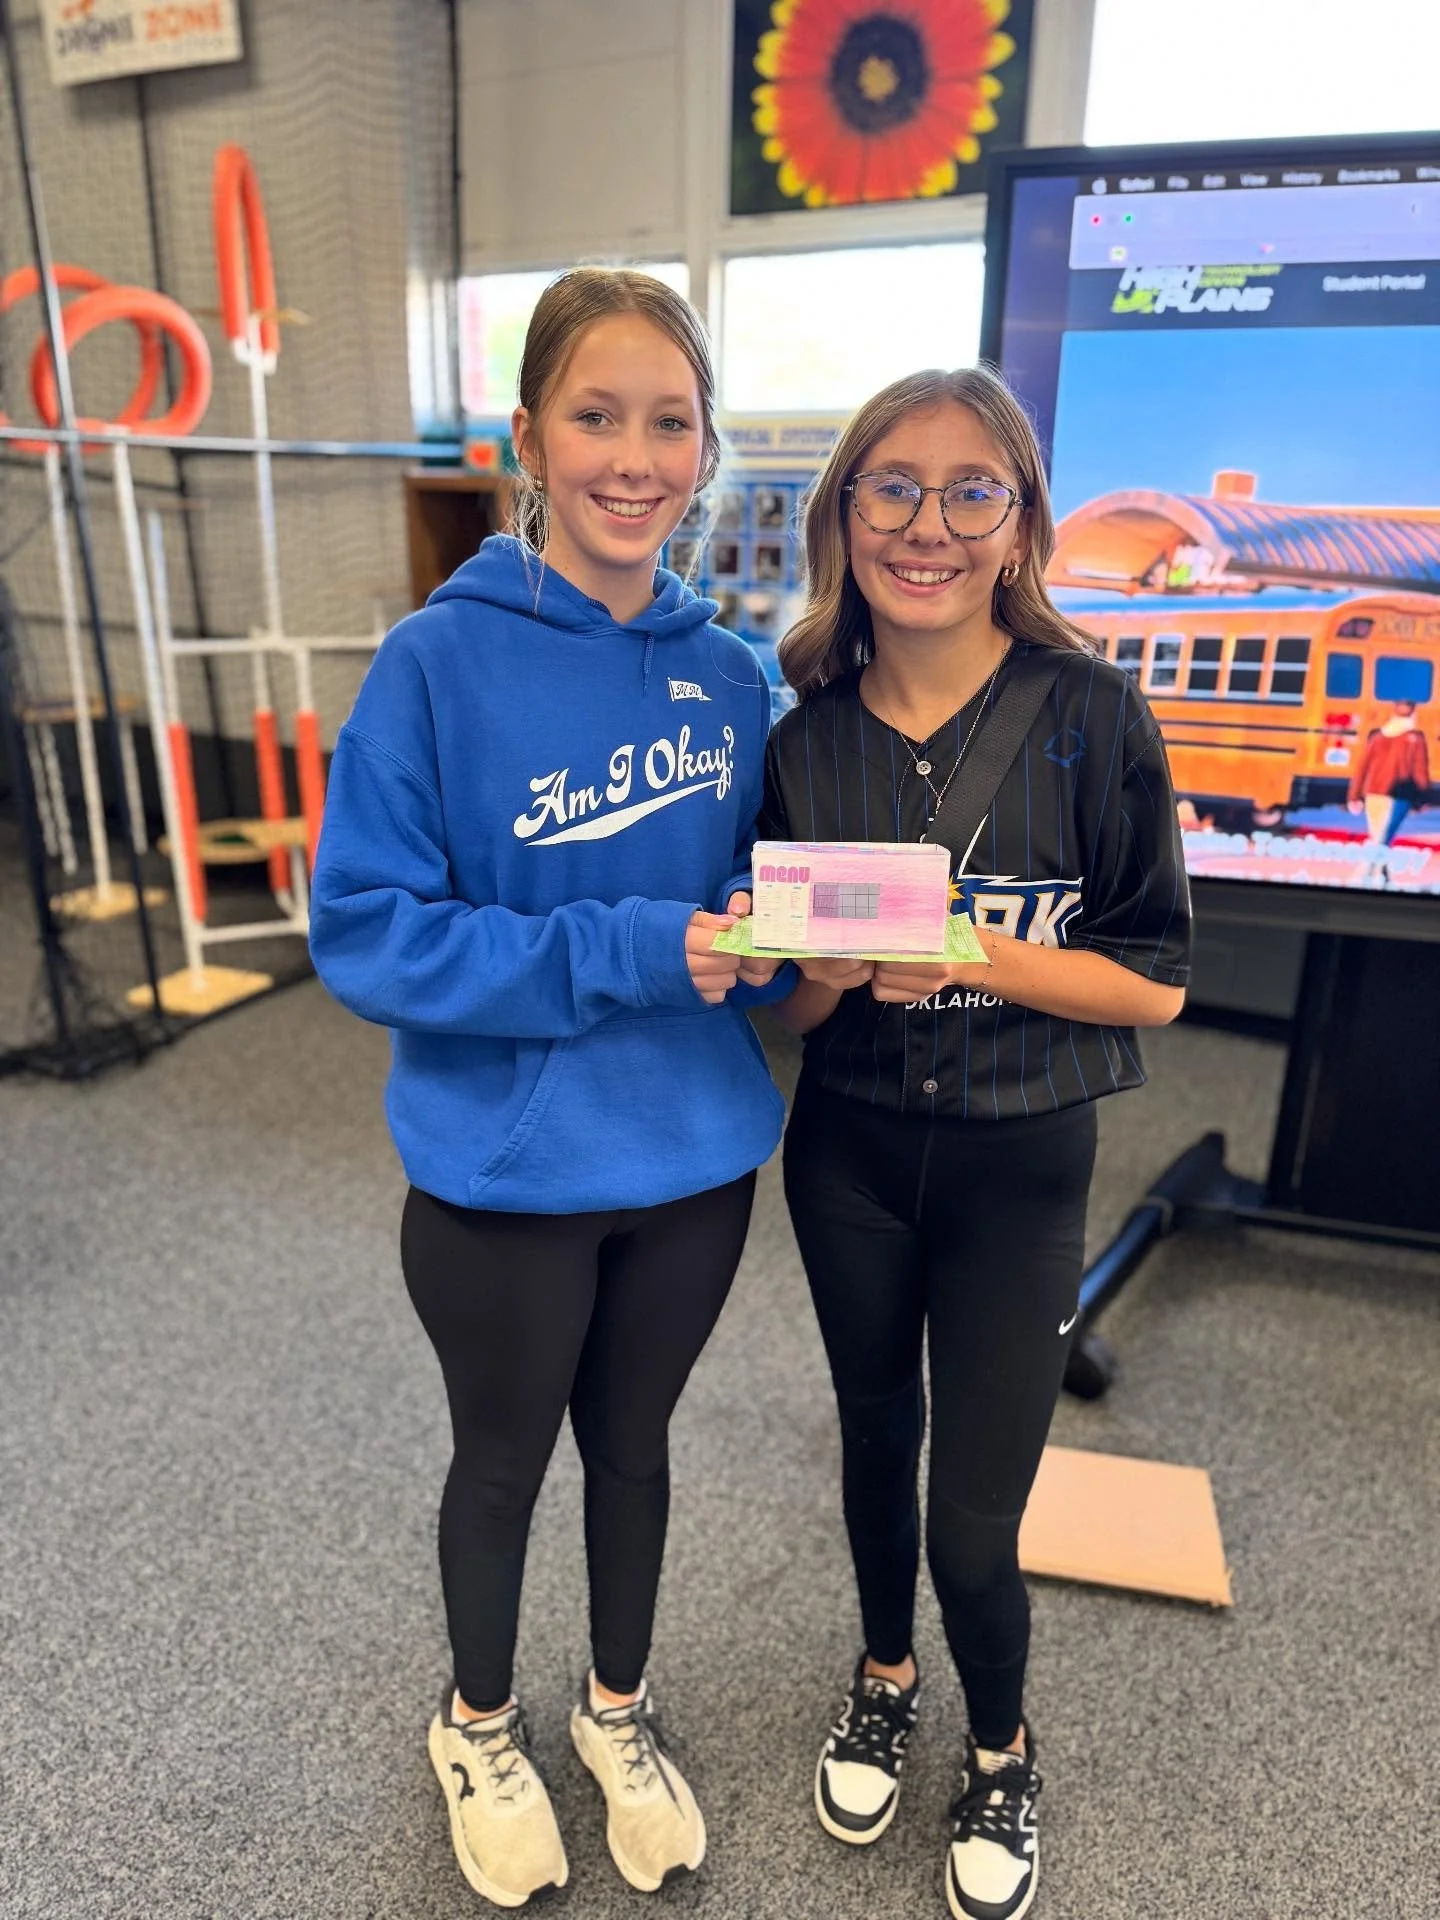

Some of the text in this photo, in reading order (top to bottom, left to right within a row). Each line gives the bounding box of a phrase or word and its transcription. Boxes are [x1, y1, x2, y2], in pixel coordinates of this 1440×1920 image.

[1323, 273, 1426, 292] Student Portal
[513, 724, 735, 839] Am I Okay?
